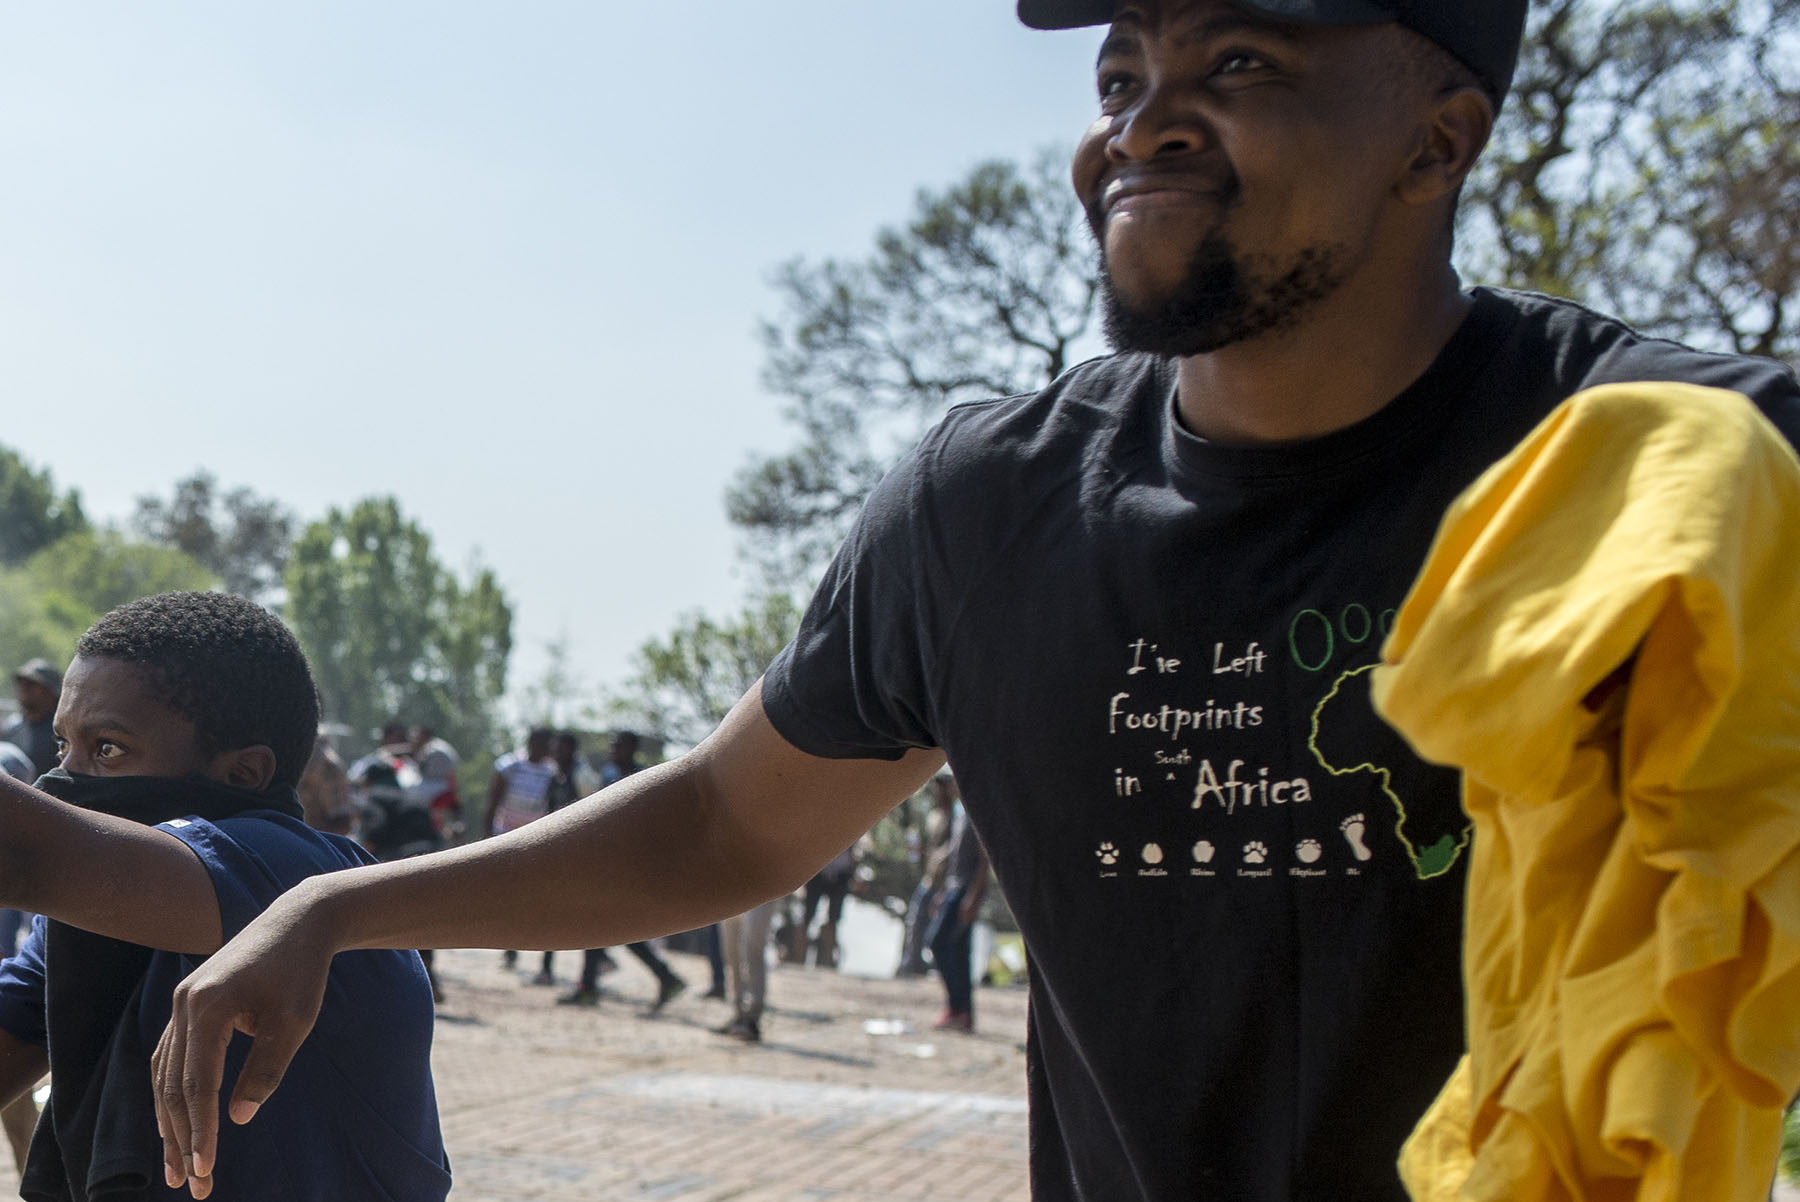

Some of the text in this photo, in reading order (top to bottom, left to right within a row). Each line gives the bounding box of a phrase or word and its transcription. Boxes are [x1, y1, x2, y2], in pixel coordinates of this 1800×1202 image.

[1212, 641, 1268, 677] Left
[1109, 692, 1264, 740] Footprints
[1114, 760, 1312, 815] in Africa
